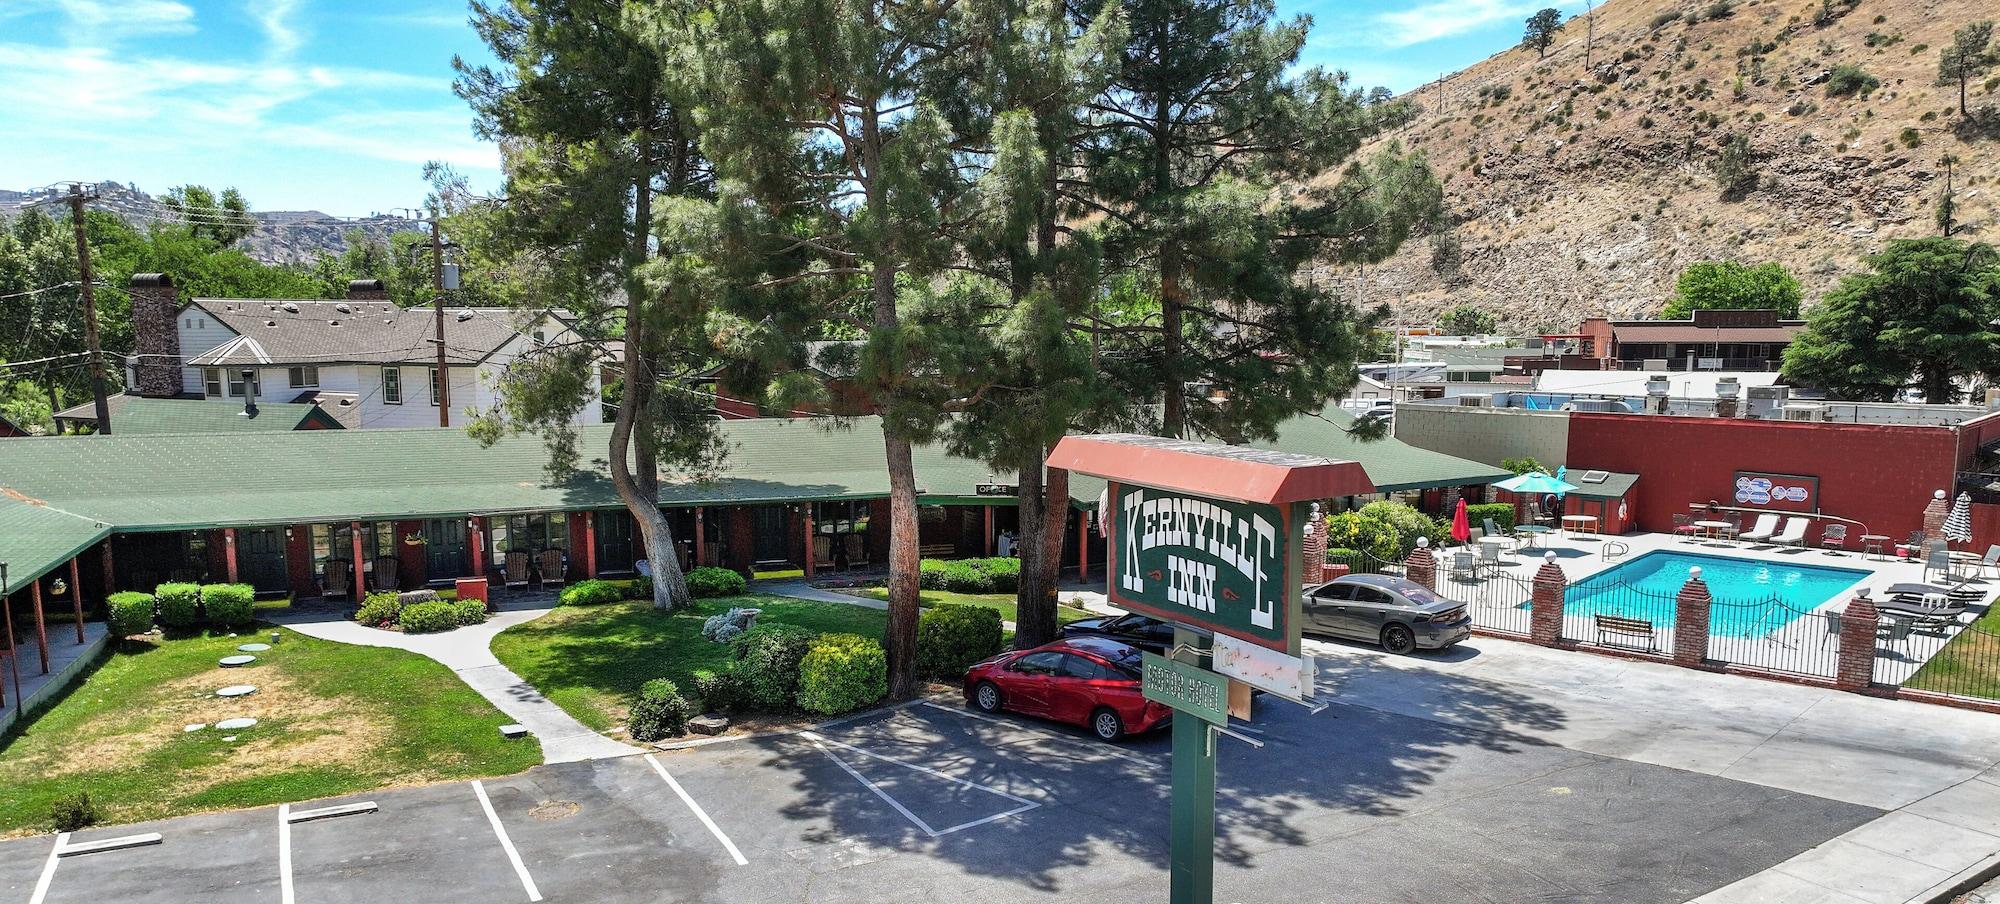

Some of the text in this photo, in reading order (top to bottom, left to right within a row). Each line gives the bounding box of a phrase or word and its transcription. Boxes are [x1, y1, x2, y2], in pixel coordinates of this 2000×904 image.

[1123, 489, 1275, 629] KERNVILLE
[1168, 555, 1216, 613] INN
[1147, 664, 1220, 713] MOTOR HOTEL
